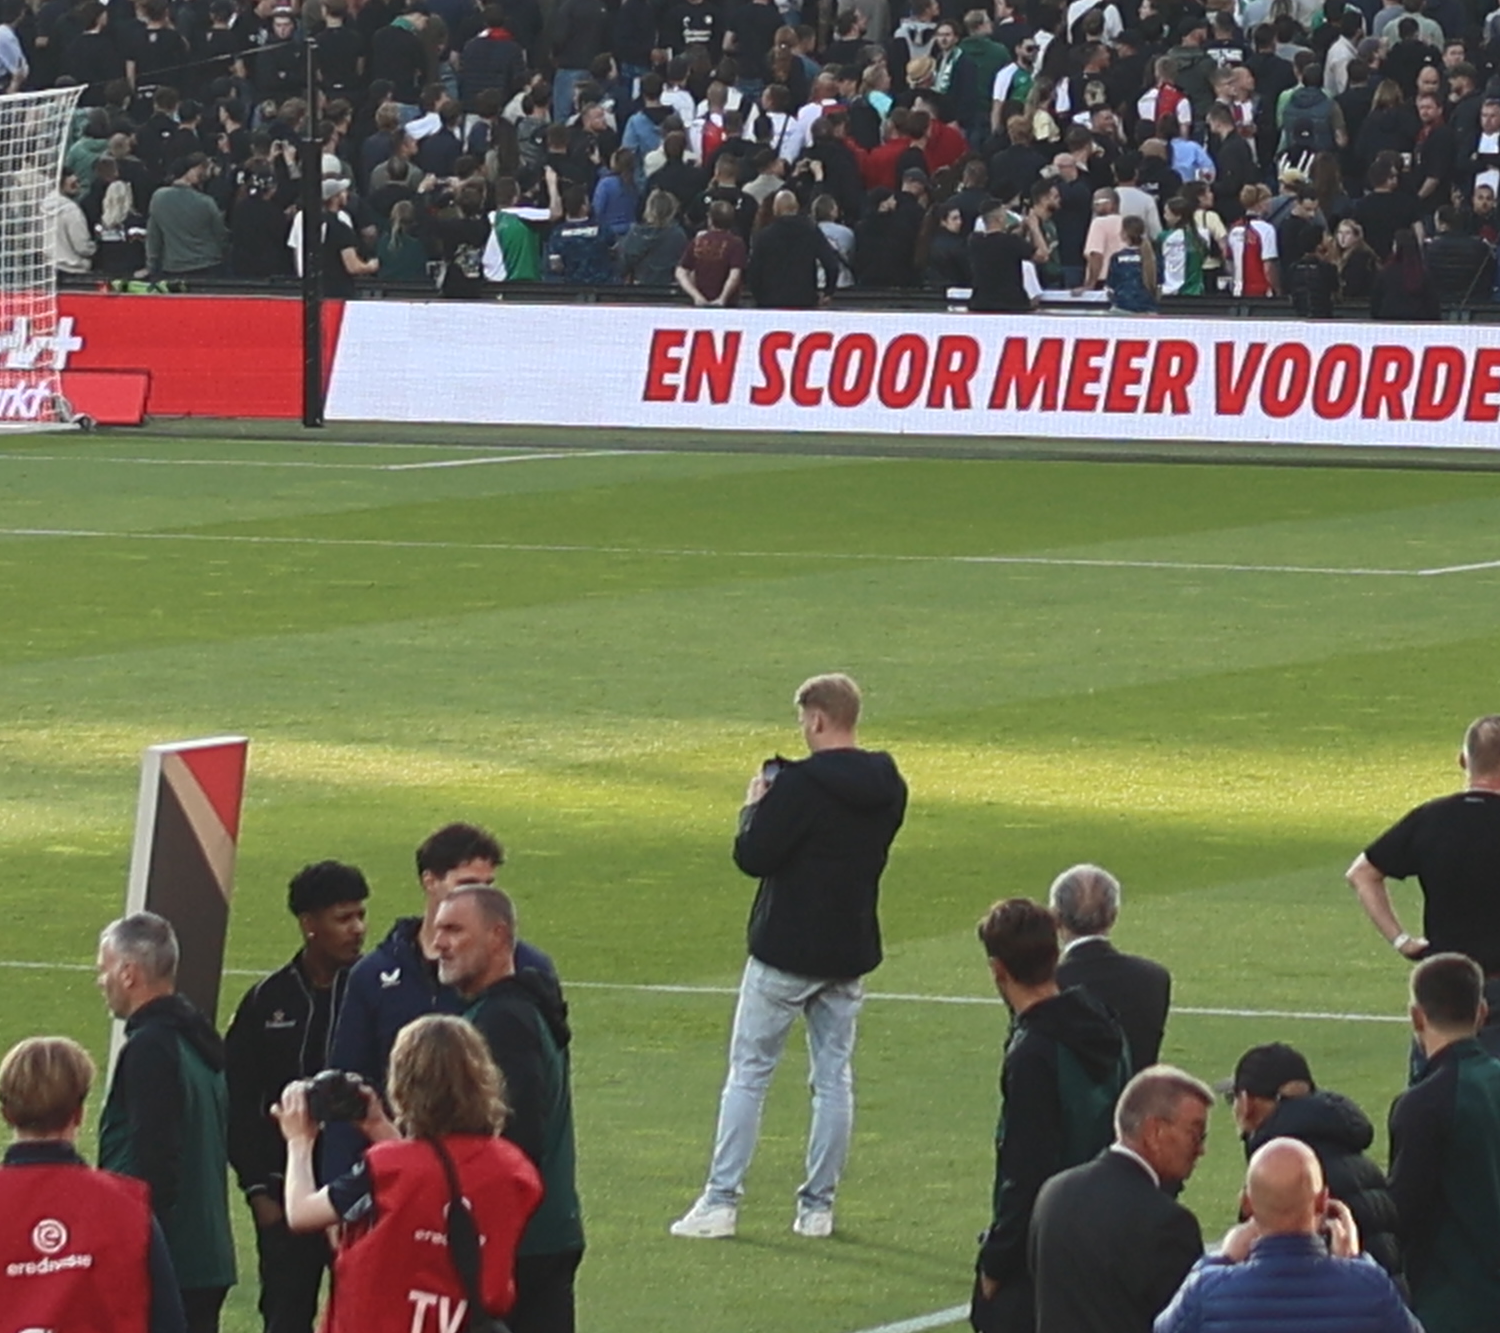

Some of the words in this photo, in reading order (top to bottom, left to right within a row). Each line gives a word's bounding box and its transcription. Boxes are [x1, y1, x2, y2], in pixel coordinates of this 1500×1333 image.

[643, 329, 739, 404] EN
[751, 331, 981, 410] SCOOR
[987, 336, 1192, 415] MEER
[409, 1289, 468, 1333] TV
